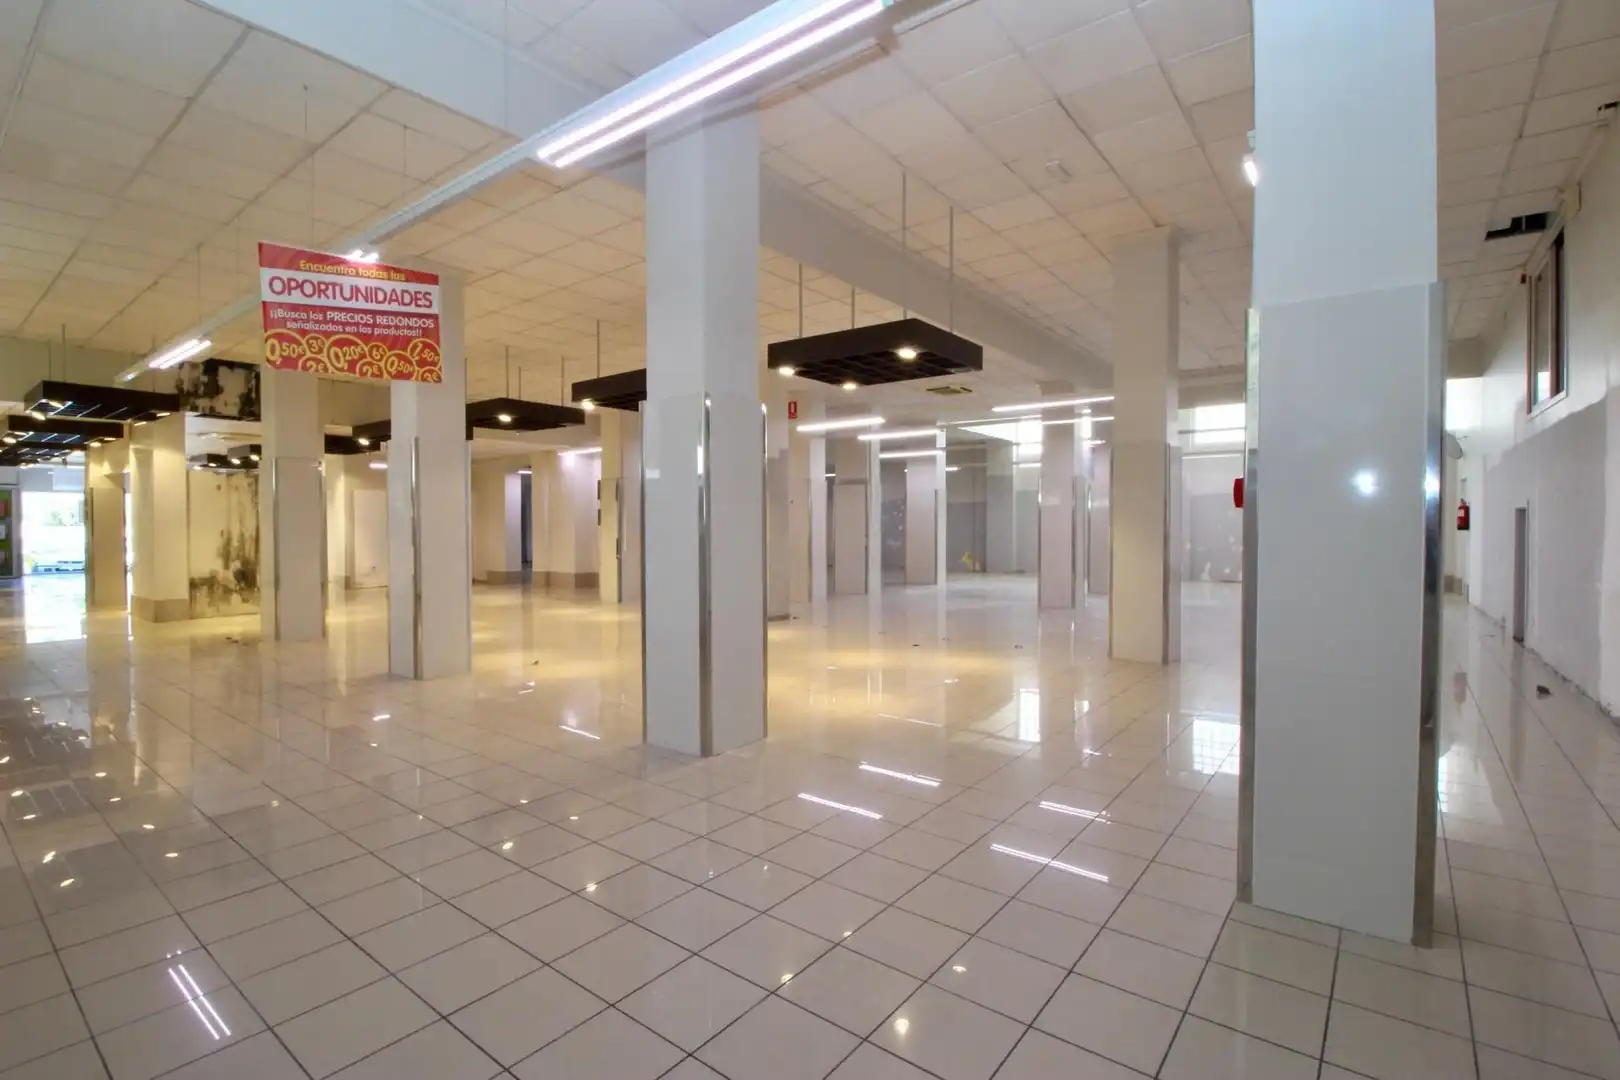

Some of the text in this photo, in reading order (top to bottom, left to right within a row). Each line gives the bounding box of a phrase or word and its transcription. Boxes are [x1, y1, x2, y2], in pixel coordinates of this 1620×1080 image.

[358, 266, 388, 280] todas
[390, 272, 406, 281] las
[268, 275, 433, 309] OPORTUNIDADES
[310, 310, 324, 320] los
[326, 311, 373, 324] PRECIOS
[376, 315, 434, 328] REDONDOS
[286, 321, 343, 332] señalizados
[360, 325, 372, 334] los
[374, 327, 422, 337] productos!!
